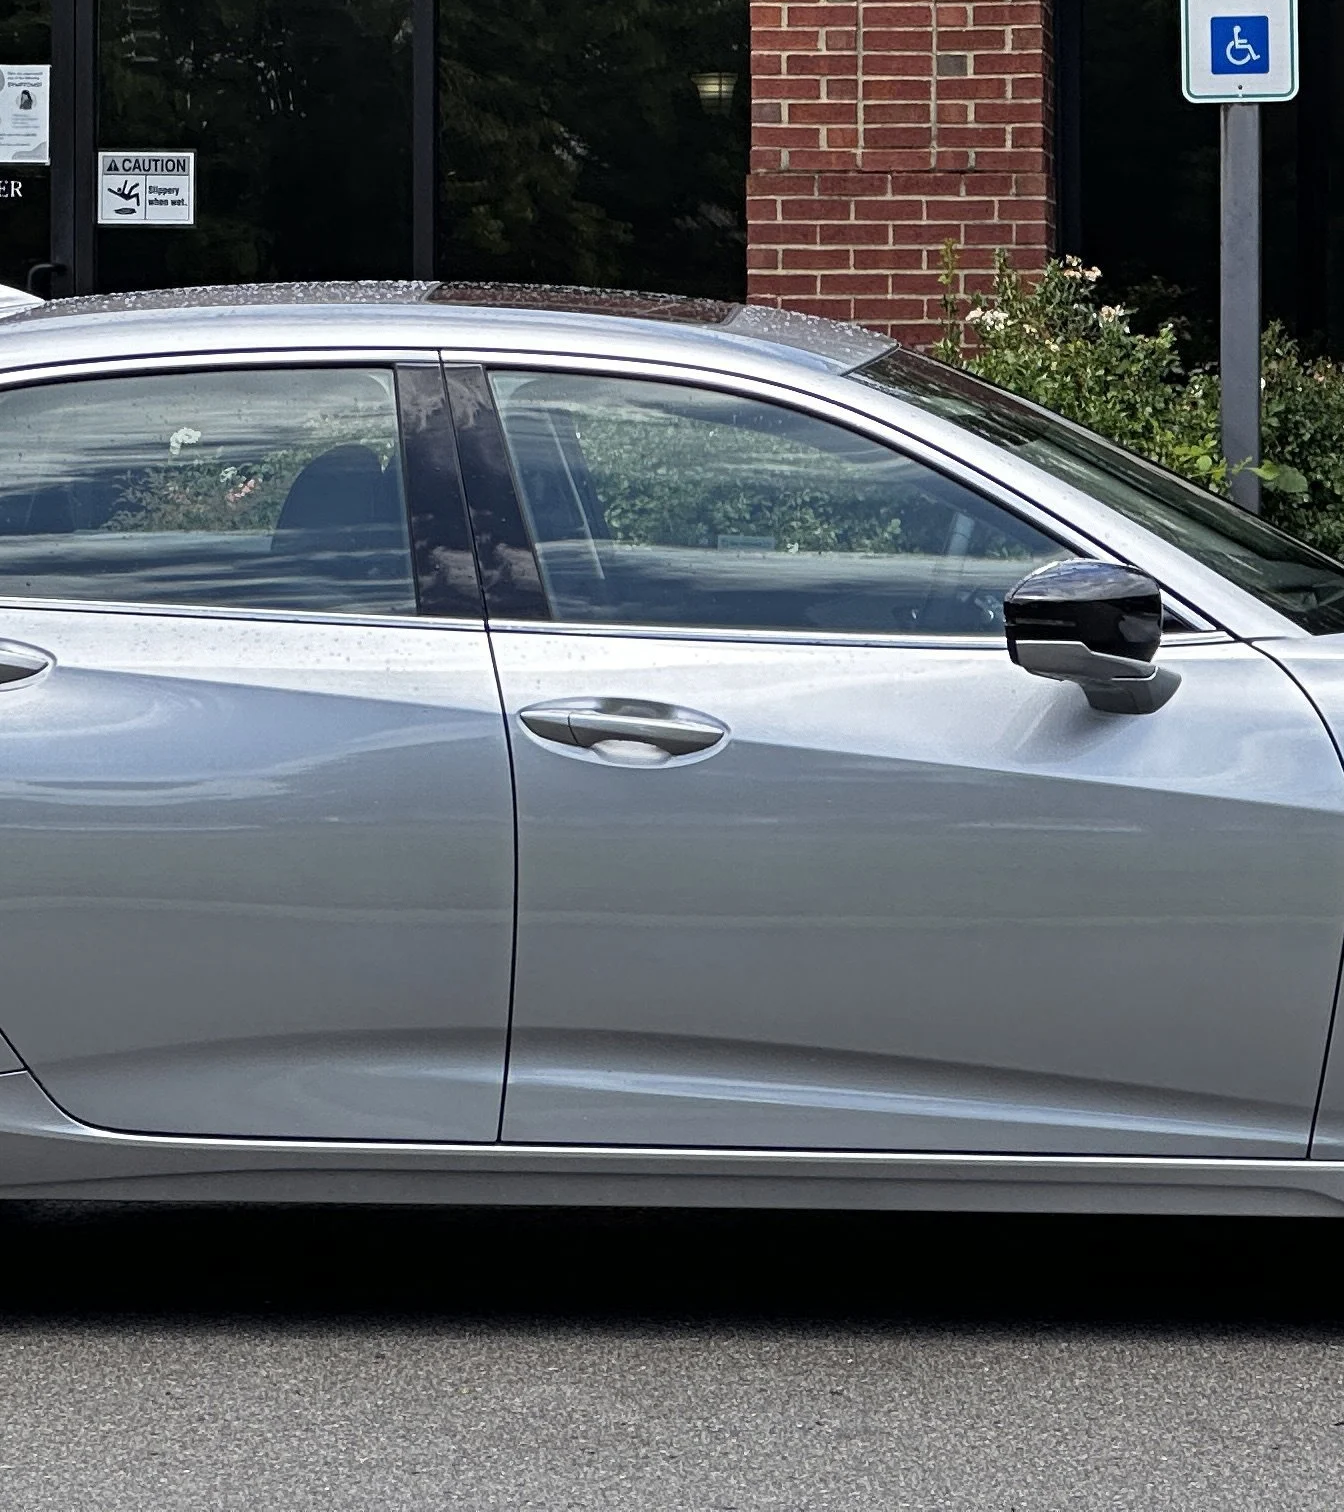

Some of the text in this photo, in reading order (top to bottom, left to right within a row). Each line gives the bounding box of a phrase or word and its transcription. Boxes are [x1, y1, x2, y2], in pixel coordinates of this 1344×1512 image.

[122, 158, 187, 173] CAUTION
[148, 185, 180, 196] Slippery
[148, 198, 169, 206] when
